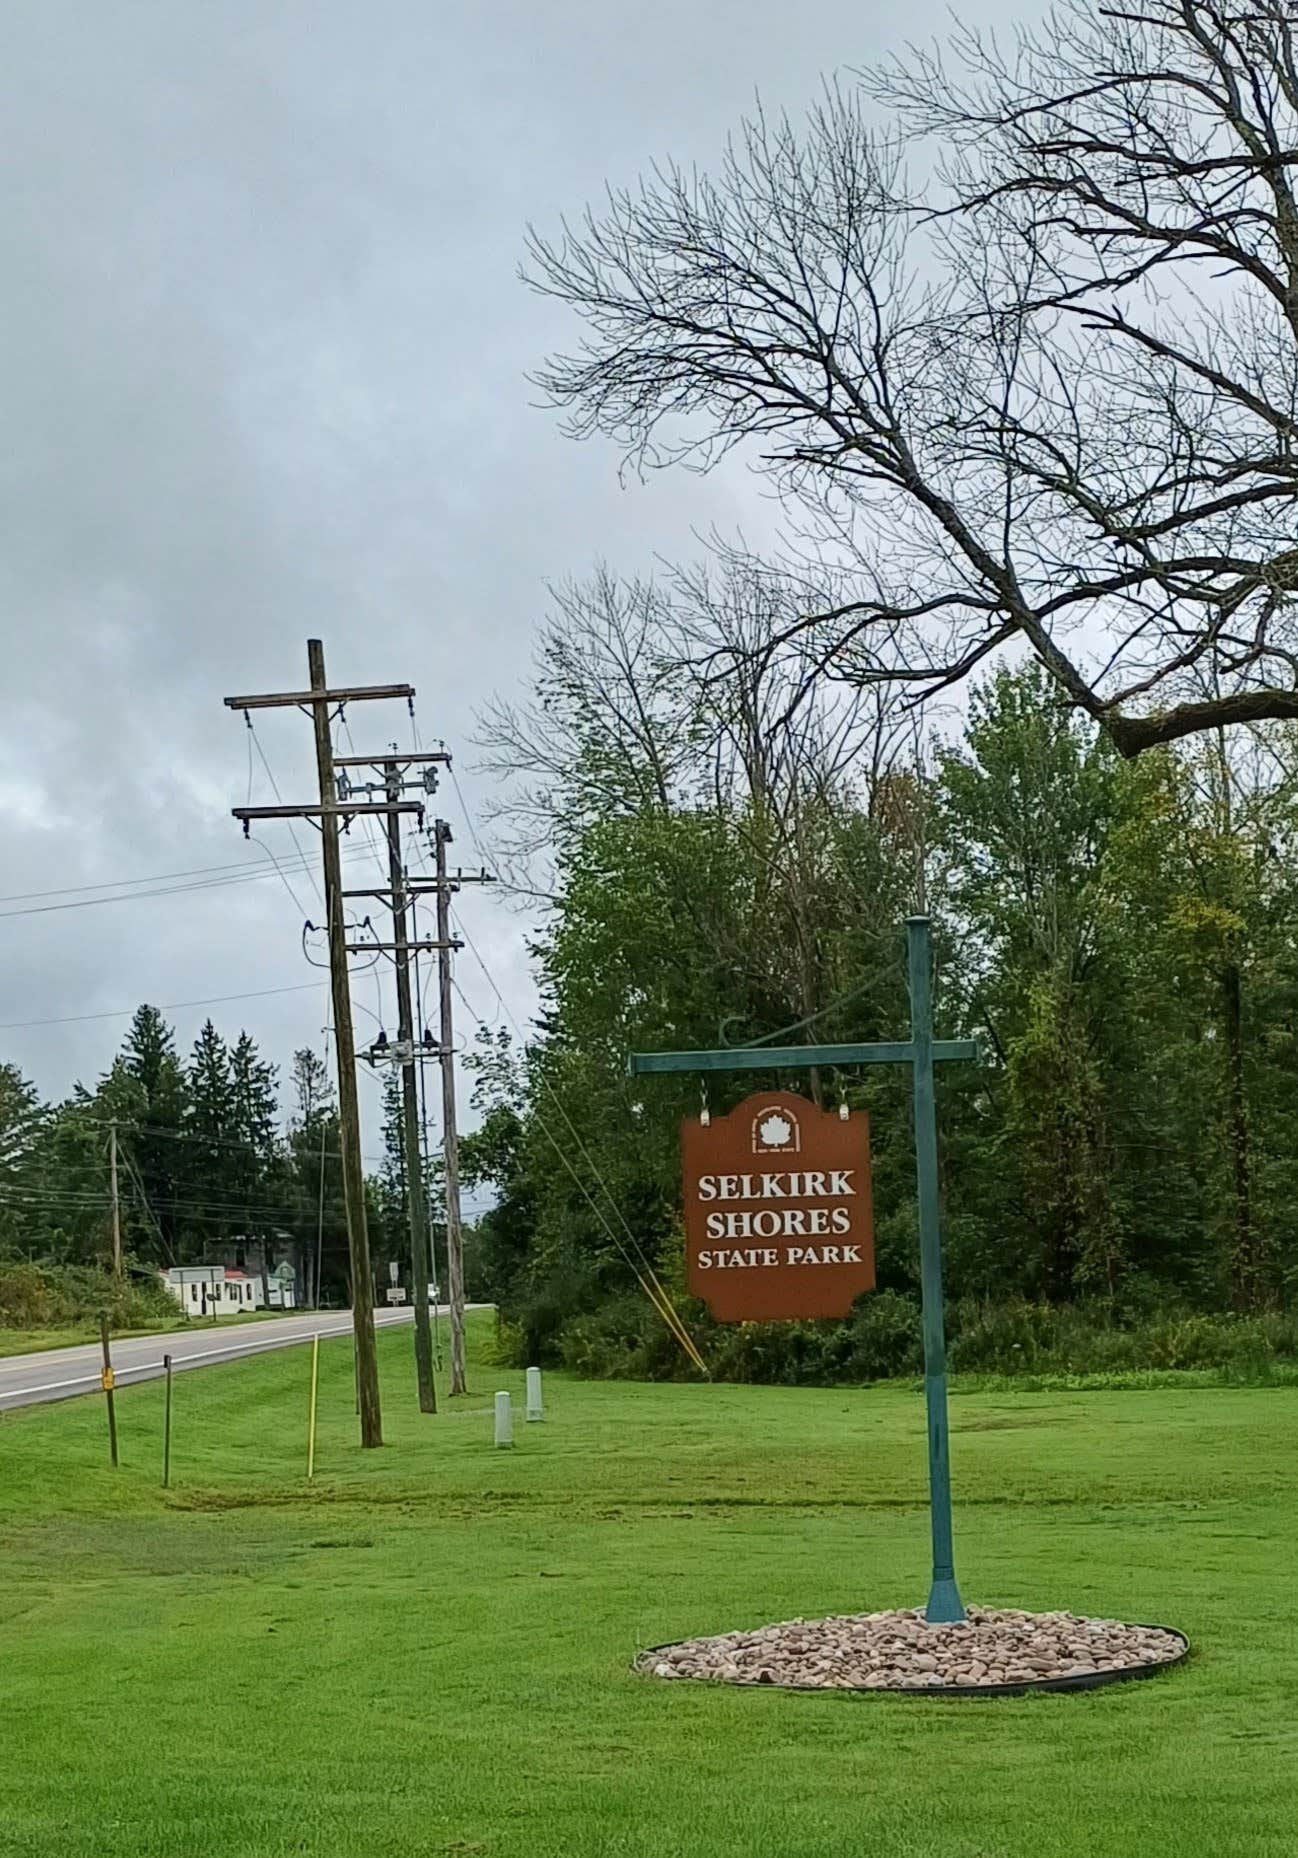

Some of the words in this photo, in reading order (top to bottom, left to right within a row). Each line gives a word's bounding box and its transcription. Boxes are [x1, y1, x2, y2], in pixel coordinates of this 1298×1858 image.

[698, 1170, 857, 1201] SELKIRK
[706, 1207, 851, 1239] SHORES
[698, 1248, 779, 1269] STATE
[786, 1245, 863, 1265] PARK
